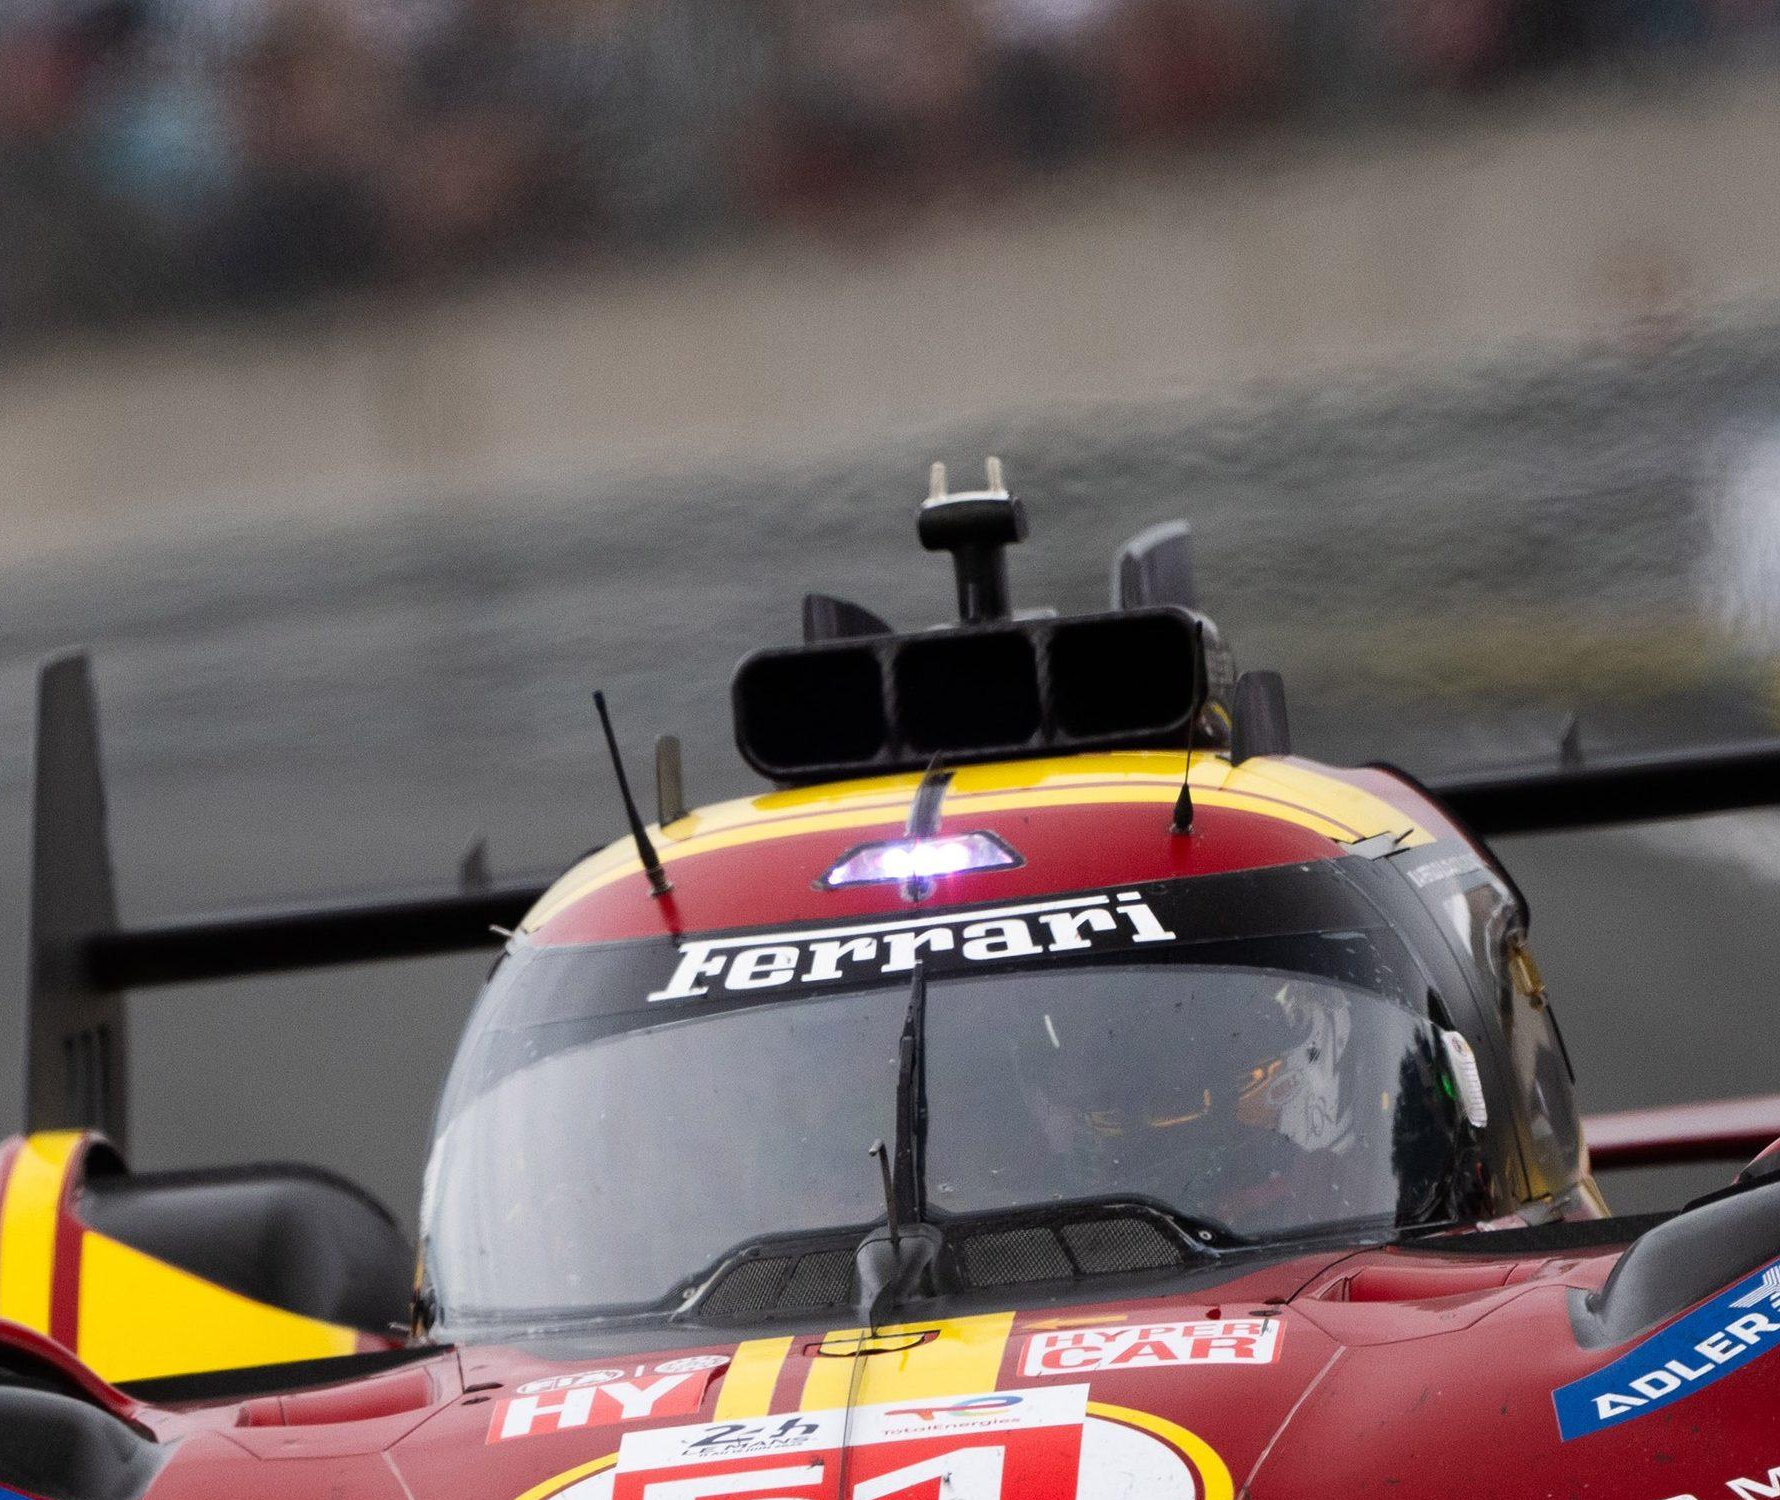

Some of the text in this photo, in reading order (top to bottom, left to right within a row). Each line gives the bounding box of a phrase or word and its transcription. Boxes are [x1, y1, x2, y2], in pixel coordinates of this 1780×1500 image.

[647, 891, 1177, 1002] Ferrari
[1045, 1322, 1262, 1348] HYPER
[1040, 1336, 1258, 1370] CAR
[499, 1373, 695, 1440] HY
[882, 1416, 1023, 1436] TotalEnergies
